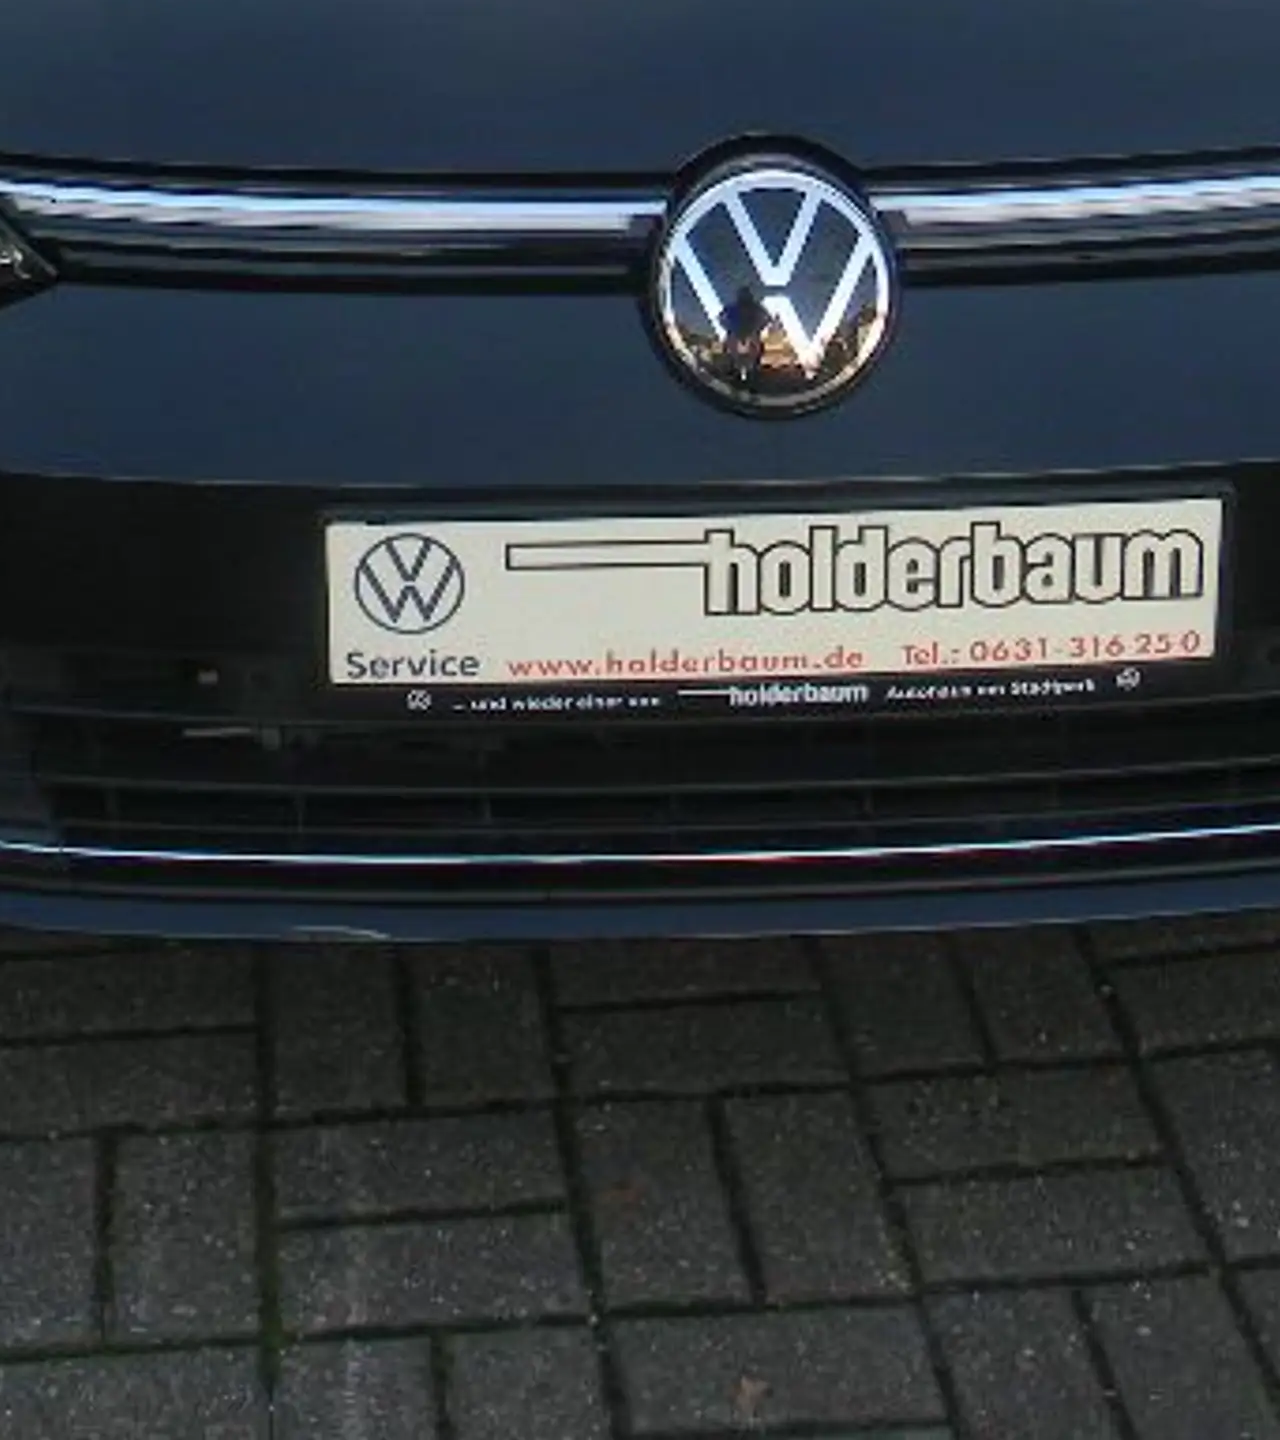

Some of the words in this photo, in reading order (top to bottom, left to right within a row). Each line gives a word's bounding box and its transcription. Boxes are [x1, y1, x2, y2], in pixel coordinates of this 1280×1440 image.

[354, 532, 465, 636] VW
[704, 521, 1204, 616] holderbaum
[346, 648, 480, 680] Service
[506, 645, 864, 678] www.holderbaum.de
[902, 641, 960, 666] Tel.:
[729, 681, 869, 706] holderbaum
